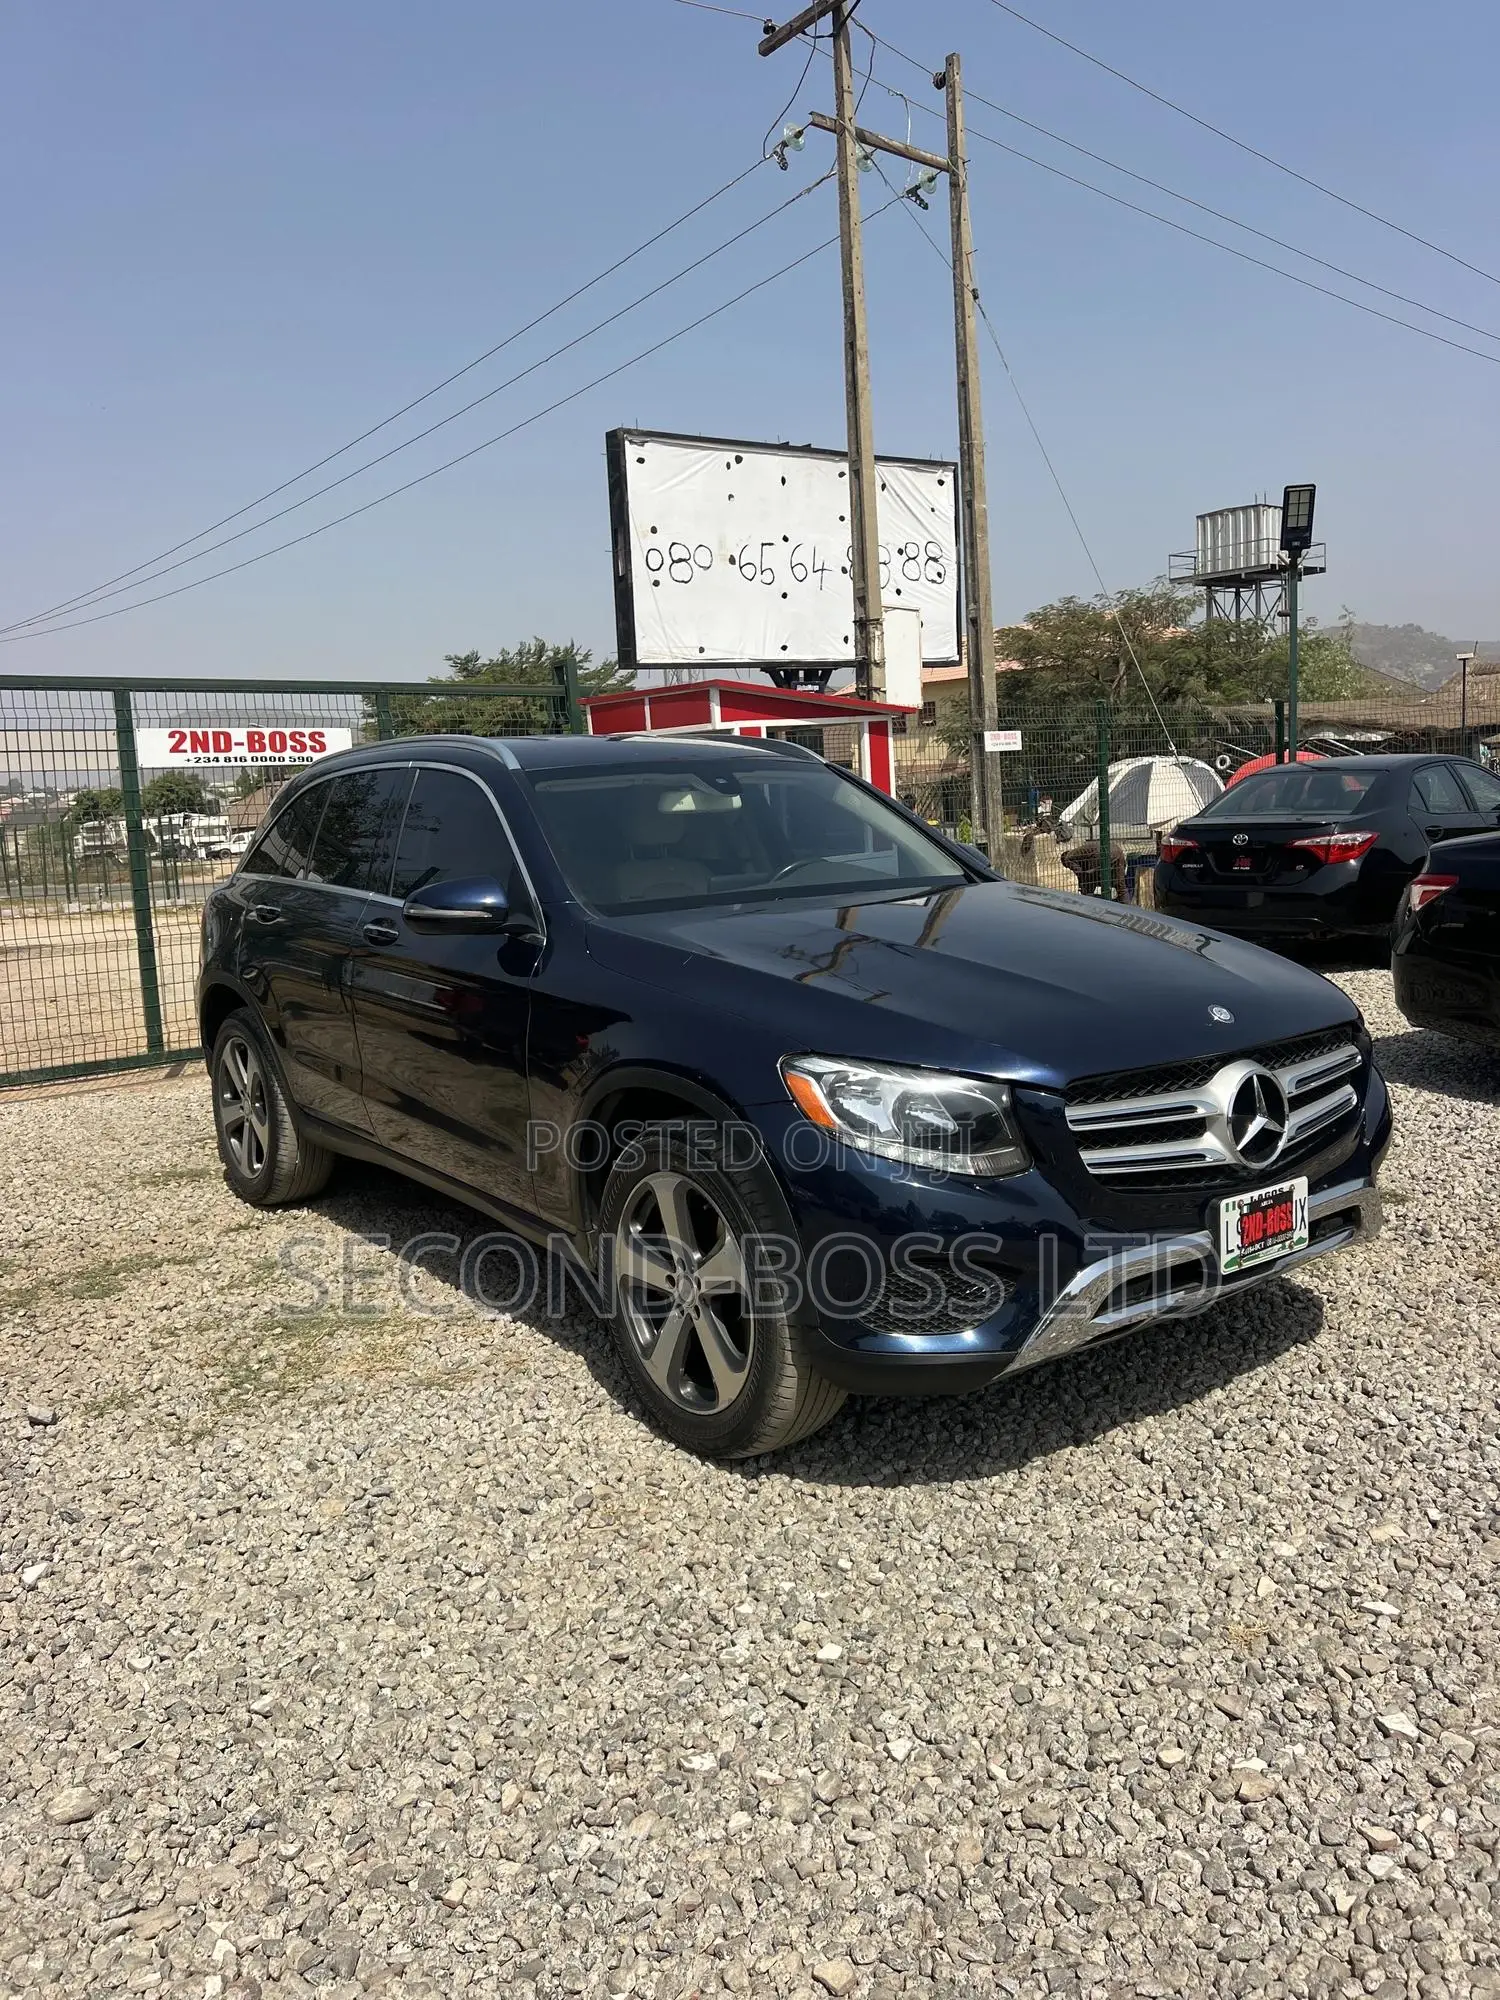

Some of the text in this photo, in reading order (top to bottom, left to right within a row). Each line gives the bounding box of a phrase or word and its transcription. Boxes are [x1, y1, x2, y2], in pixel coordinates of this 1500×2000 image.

[646, 542, 713, 583] 080
[738, 543, 775, 585] 65
[790, 543, 833, 591] 64
[168, 730, 327, 754] 2ND-BOSS
[185, 755, 314, 764] +234 816 0000 590
[1242, 1202, 1293, 1247] 2ND-BOSS
